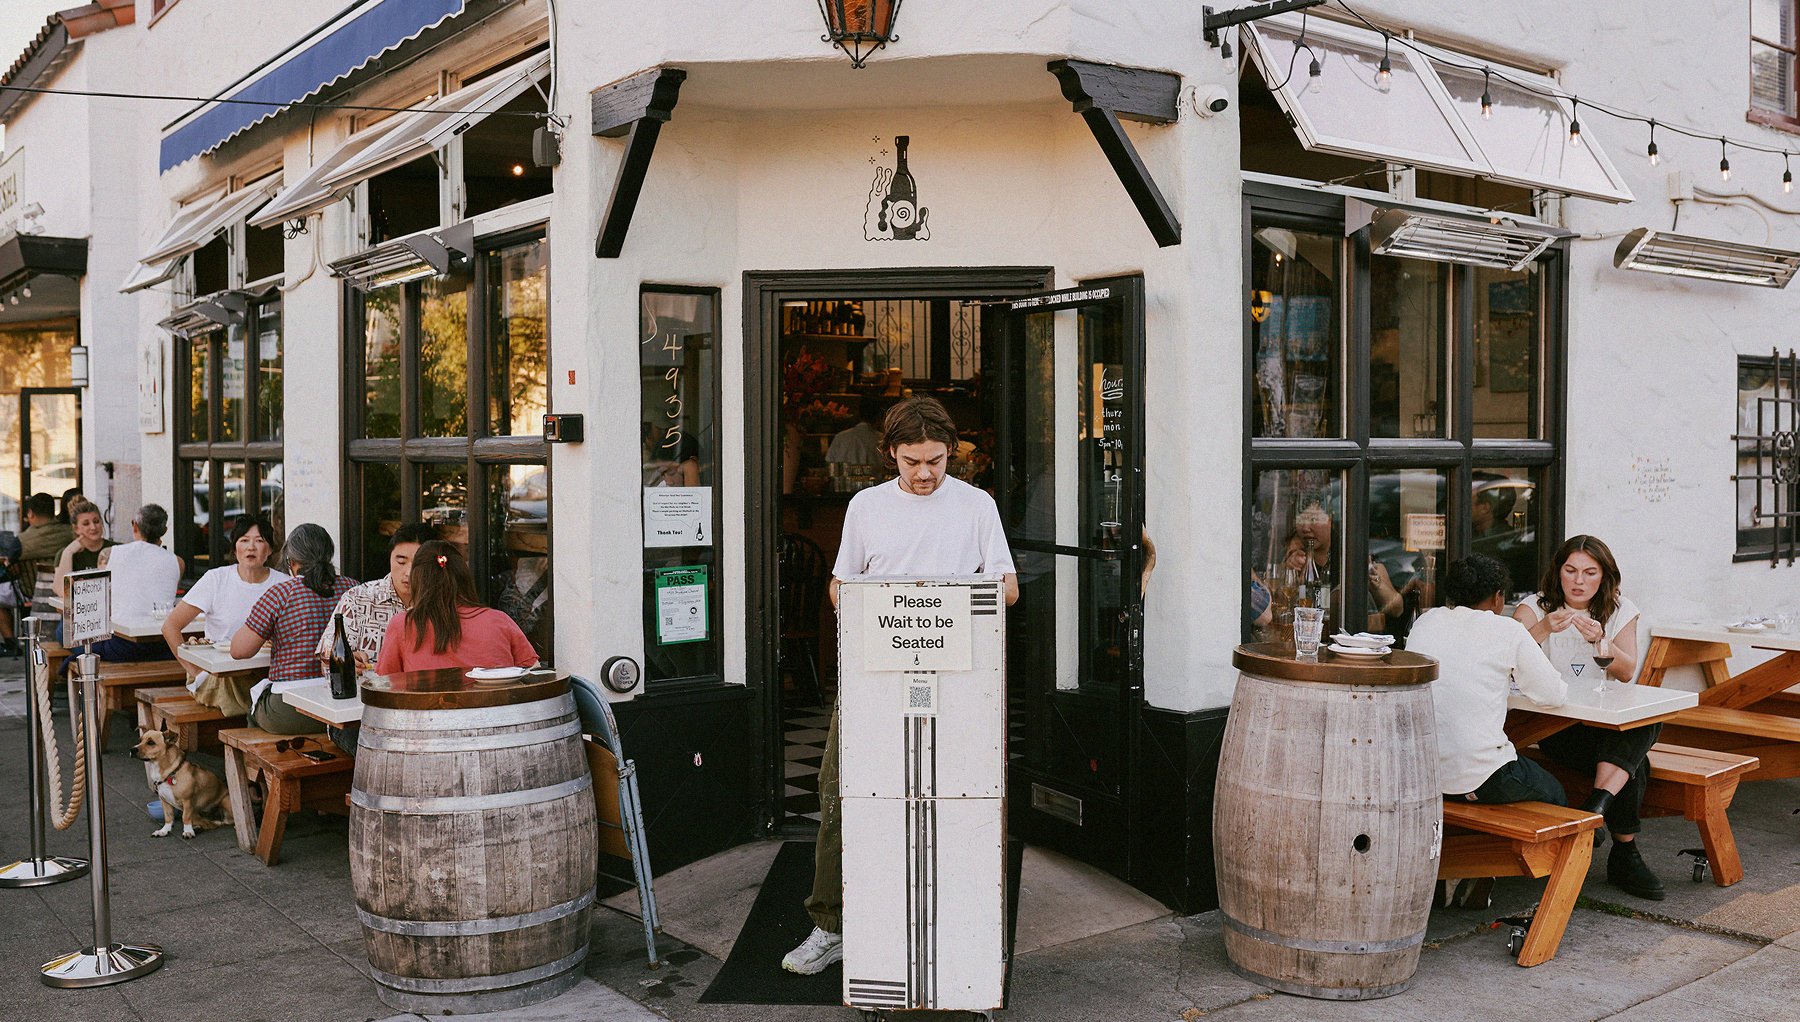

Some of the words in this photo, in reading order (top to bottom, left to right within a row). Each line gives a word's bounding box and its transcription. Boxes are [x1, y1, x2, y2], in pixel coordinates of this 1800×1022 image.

[1062, 293, 1072, 303] WHILE
[1073, 291, 1088, 301] BUILDING
[1093, 288, 1110, 299] OCCUPIED
[666, 574, 695, 586] PASS
[81, 580, 102, 595] Alcohol
[76, 600, 98, 616] Beyond
[893, 594, 942, 608] Please
[73, 621, 86, 634] This
[86, 618, 102, 633] Point
[878, 615, 913, 629] Wait
[916, 616, 932, 629] to
[935, 615, 954, 629] be
[891, 635, 944, 649] Seated
